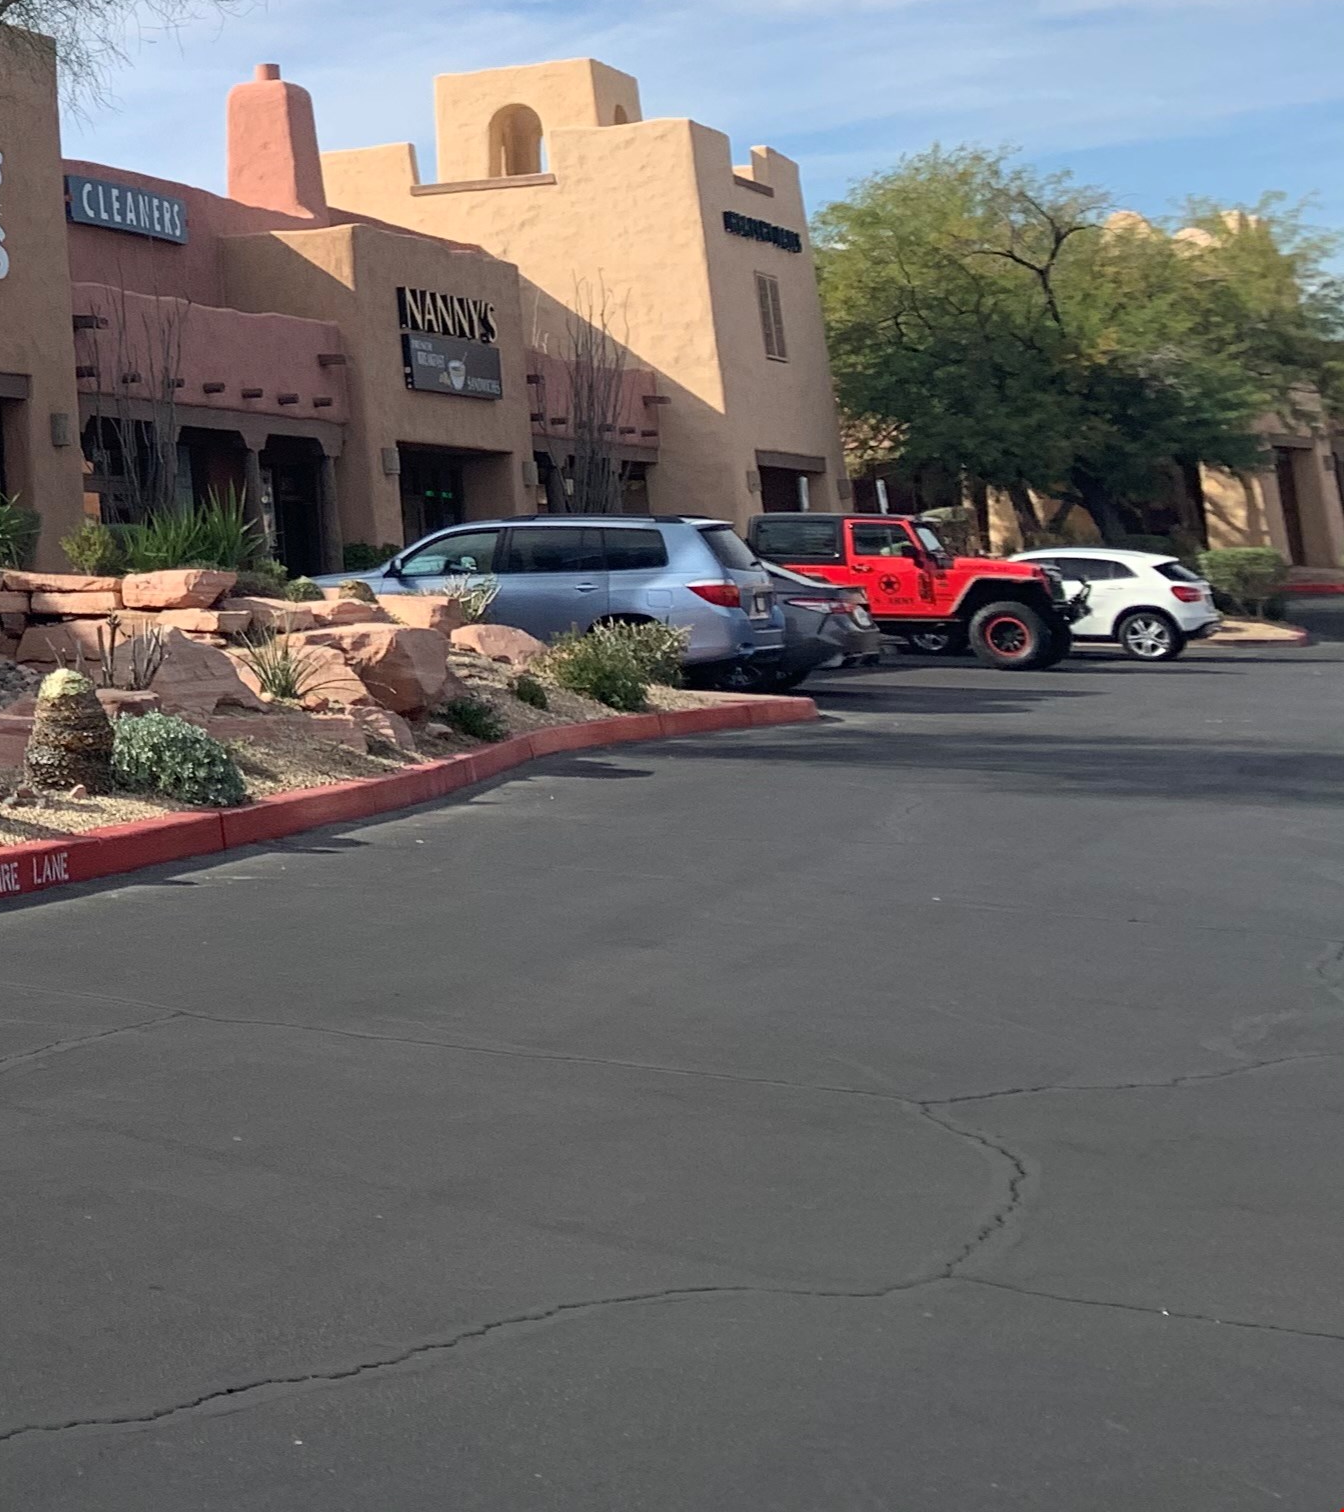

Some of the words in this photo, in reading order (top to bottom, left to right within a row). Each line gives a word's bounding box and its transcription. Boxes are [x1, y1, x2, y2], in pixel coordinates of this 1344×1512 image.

[81, 182, 182, 237] CLEANERS
[404, 286, 498, 343] NANNY'S
[32, 852, 70, 885] LANE
